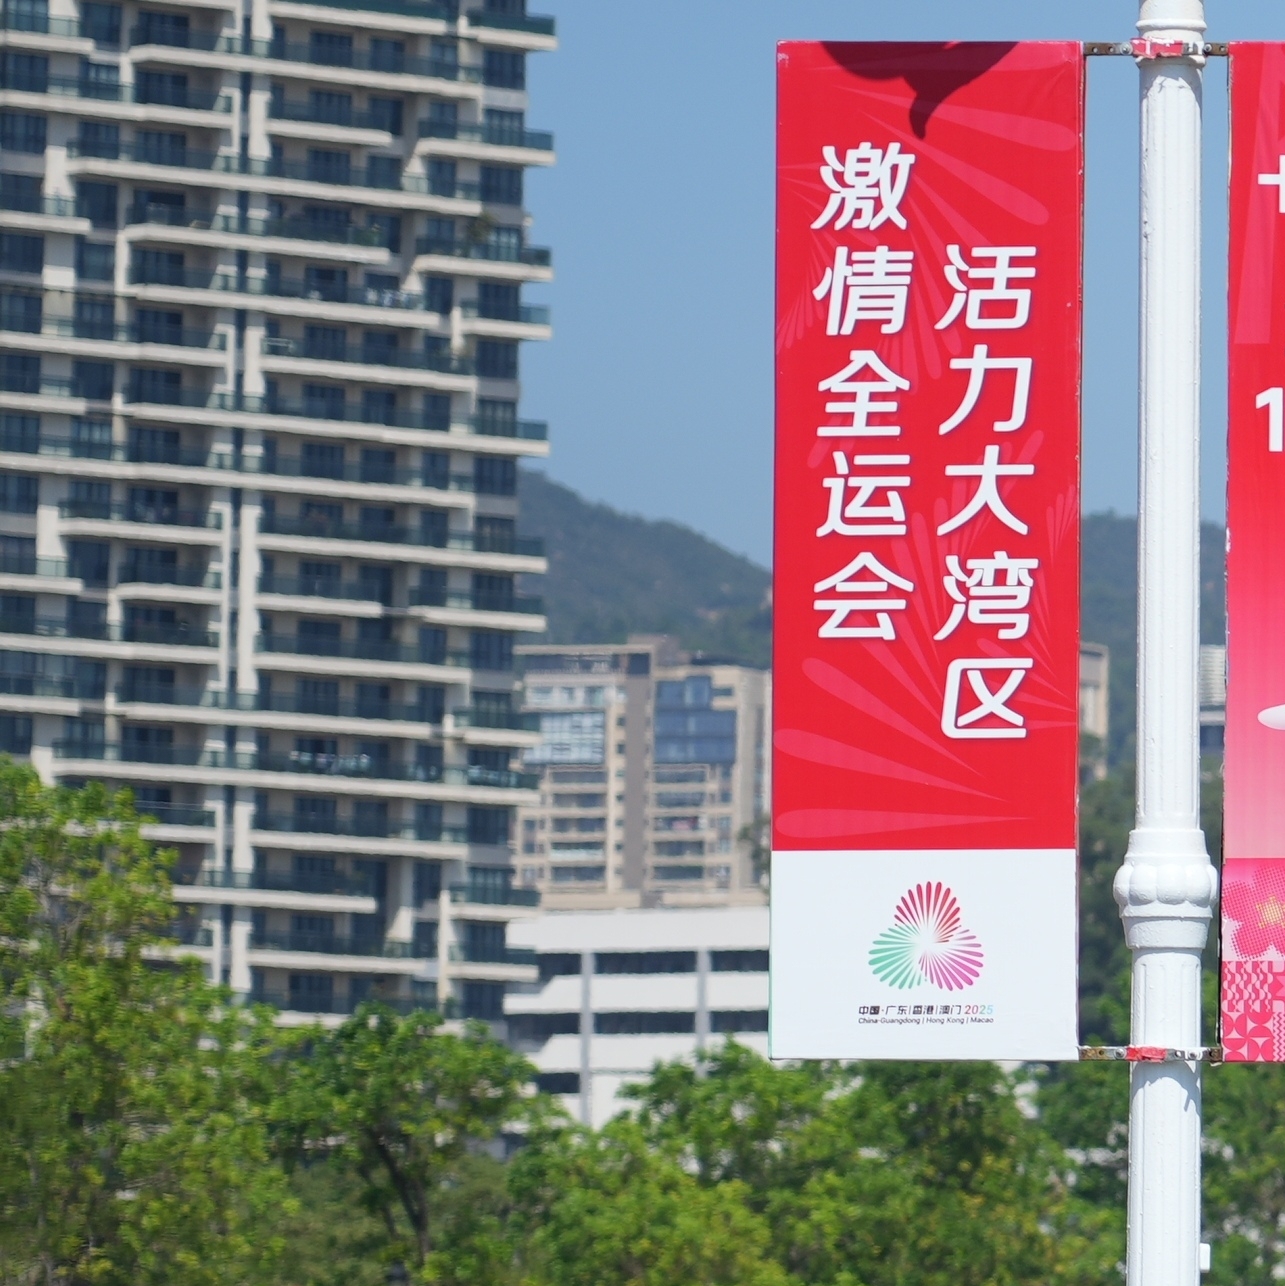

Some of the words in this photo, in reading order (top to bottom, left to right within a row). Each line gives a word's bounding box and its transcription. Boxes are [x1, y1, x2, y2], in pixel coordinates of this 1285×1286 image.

[810, 141, 915, 641] 激情全运会
[933, 243, 1039, 740] 活力大湾区
[964, 1004, 994, 1015] 2025
